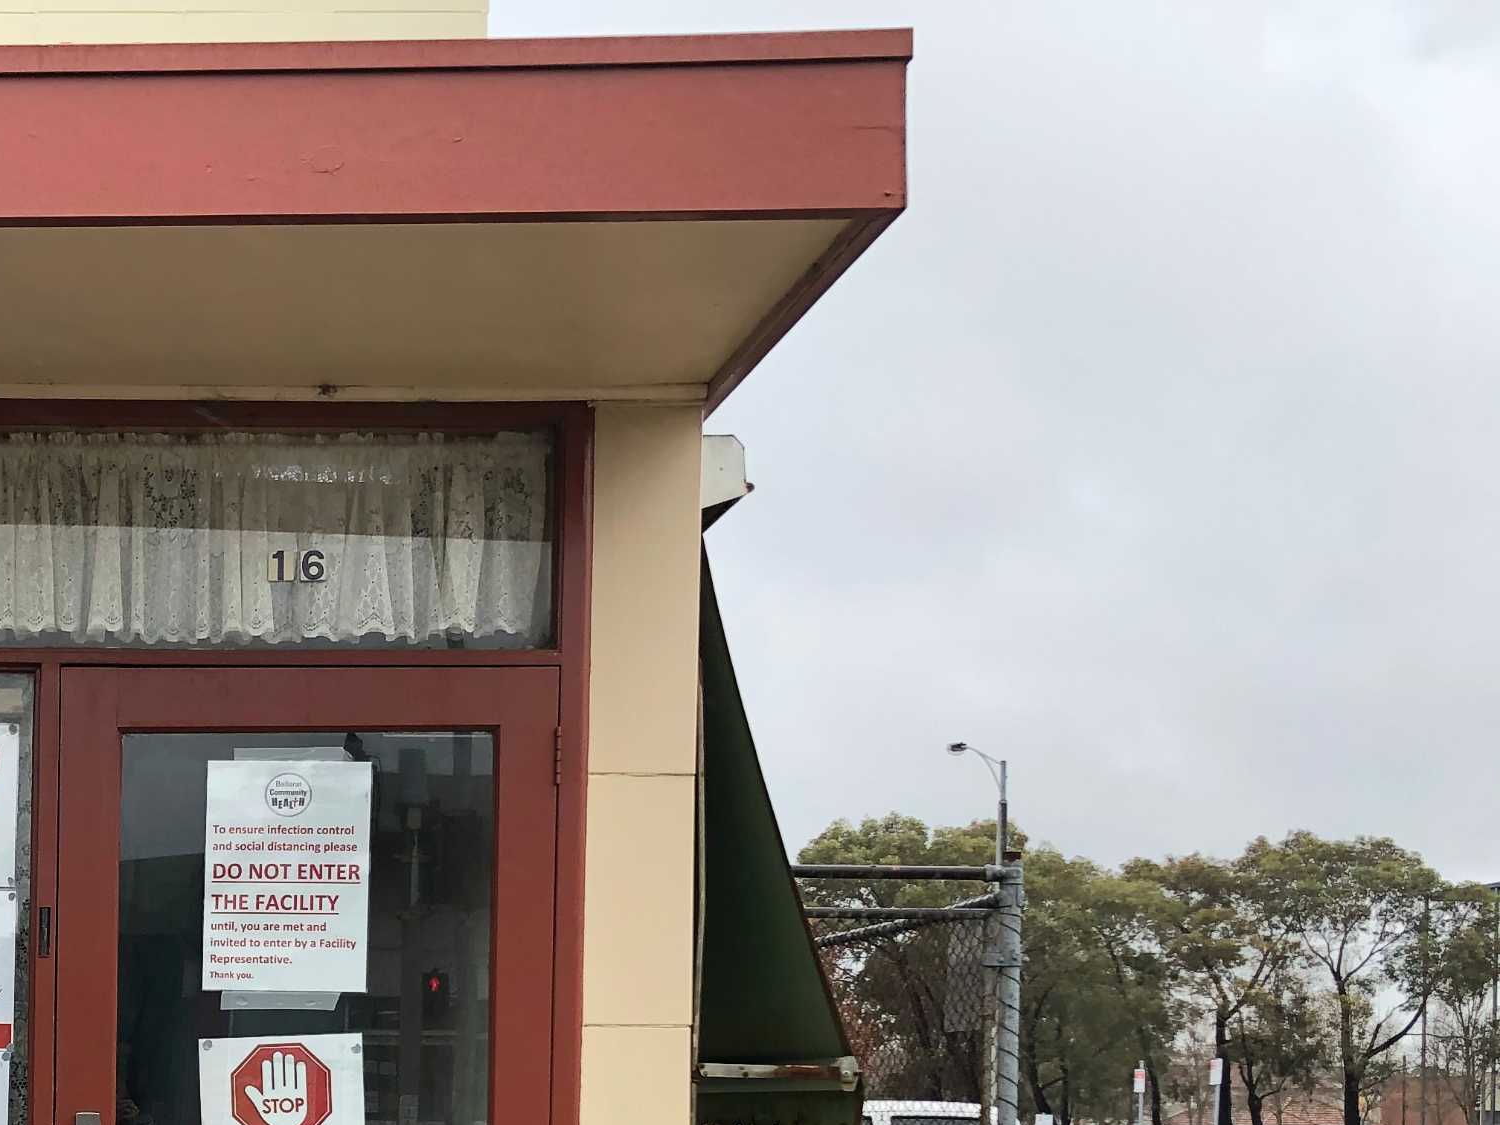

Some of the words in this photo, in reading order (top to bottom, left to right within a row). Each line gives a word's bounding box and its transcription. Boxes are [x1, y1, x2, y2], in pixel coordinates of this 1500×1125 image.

[272, 550, 324, 581] 16
[213, 825, 226, 834] To
[267, 825, 314, 835] infection
[316, 825, 355, 835] control
[212, 841, 232, 851] and
[235, 841, 264, 851] social
[267, 841, 321, 853] distancing
[324, 842, 357, 854] please
[213, 863, 242, 879] DO
[249, 863, 292, 880] NOT
[297, 864, 360, 880] ENTER
[211, 894, 249, 911] THE
[255, 894, 339, 911] FACILITY
[211, 922, 237, 932] until,
[240, 923, 260, 933] you
[283, 923, 304, 931] met
[307, 922, 327, 931] and
[210, 938, 246, 947] invited
[250, 939, 260, 947] to
[263, 940, 291, 948] enter
[294, 939, 307, 949] by
[320, 938, 357, 950] Facility
[210, 954, 293, 965] Representative.
[210, 971, 234, 979] Thank
[236, 972, 255, 980] you.
[262, 1098, 304, 1114] STOP
